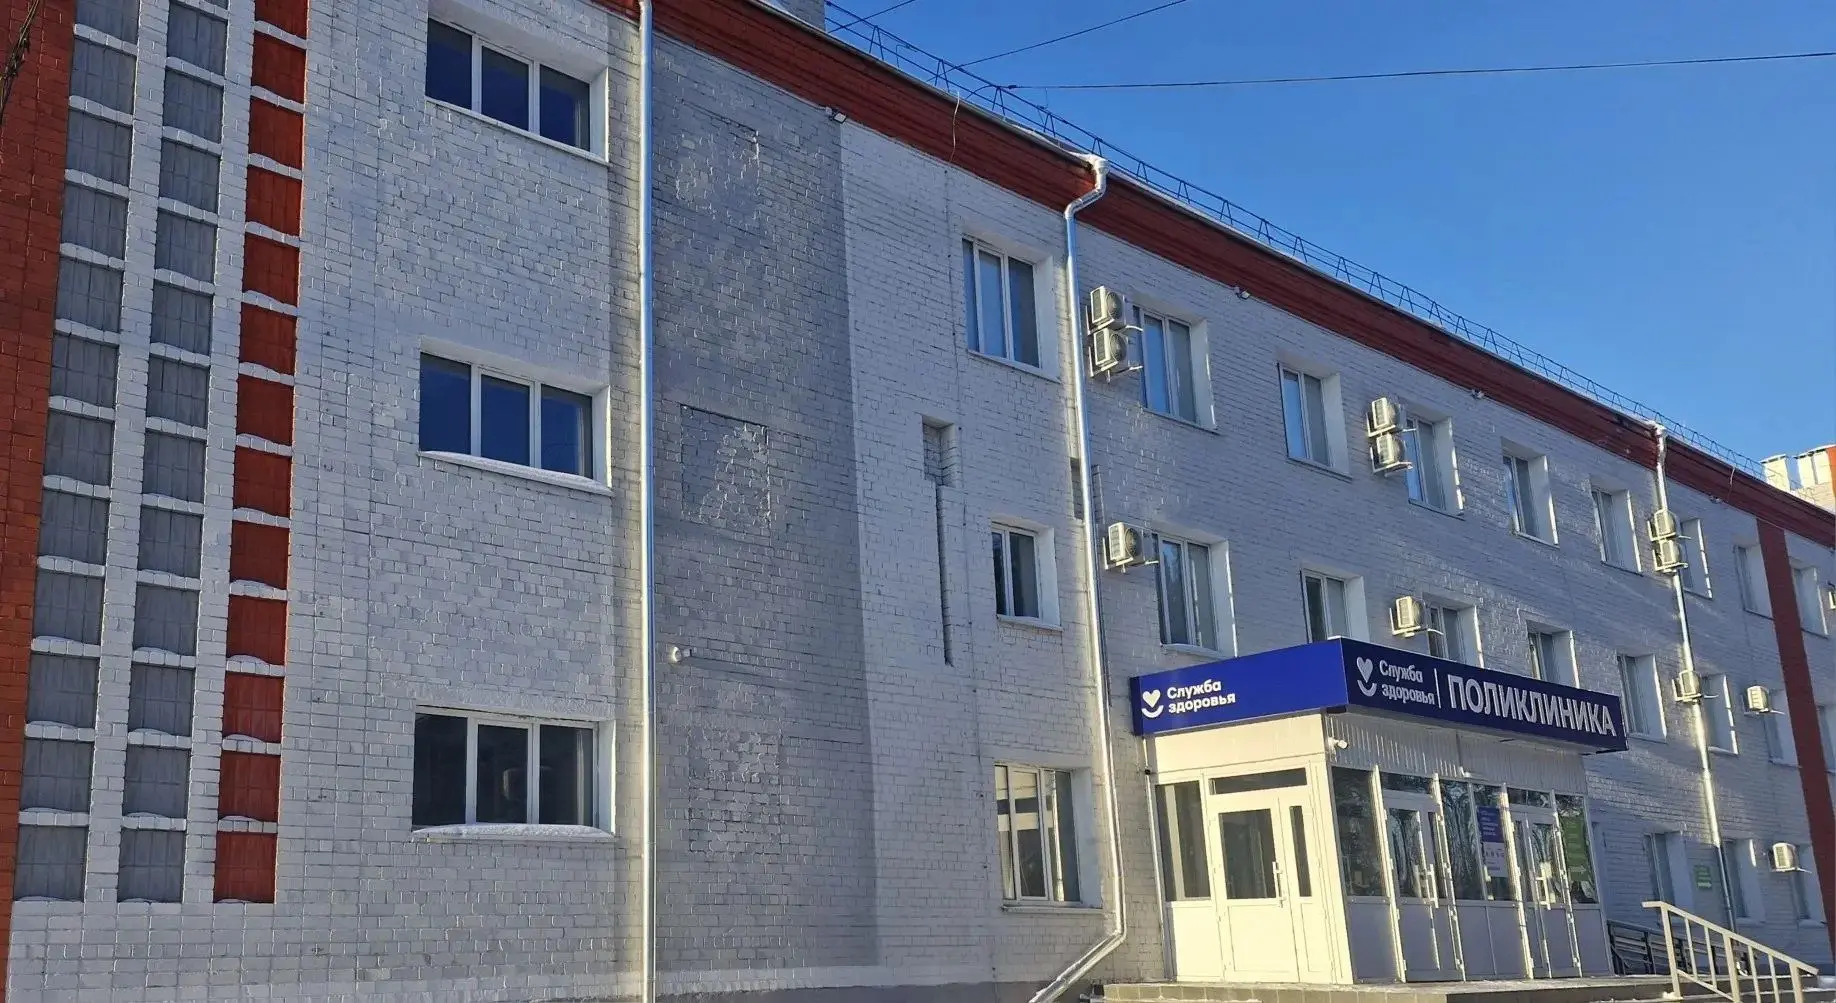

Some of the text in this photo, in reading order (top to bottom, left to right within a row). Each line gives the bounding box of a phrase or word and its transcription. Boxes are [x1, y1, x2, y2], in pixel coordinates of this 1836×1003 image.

[1379, 660, 1423, 683] Служба
[1166, 679, 1222, 700] Служба
[1381, 683, 1435, 705] здоровья
[1168, 693, 1236, 713] здоровья
[1447, 674, 1617, 737] ПОЛИКЛИНИКА
